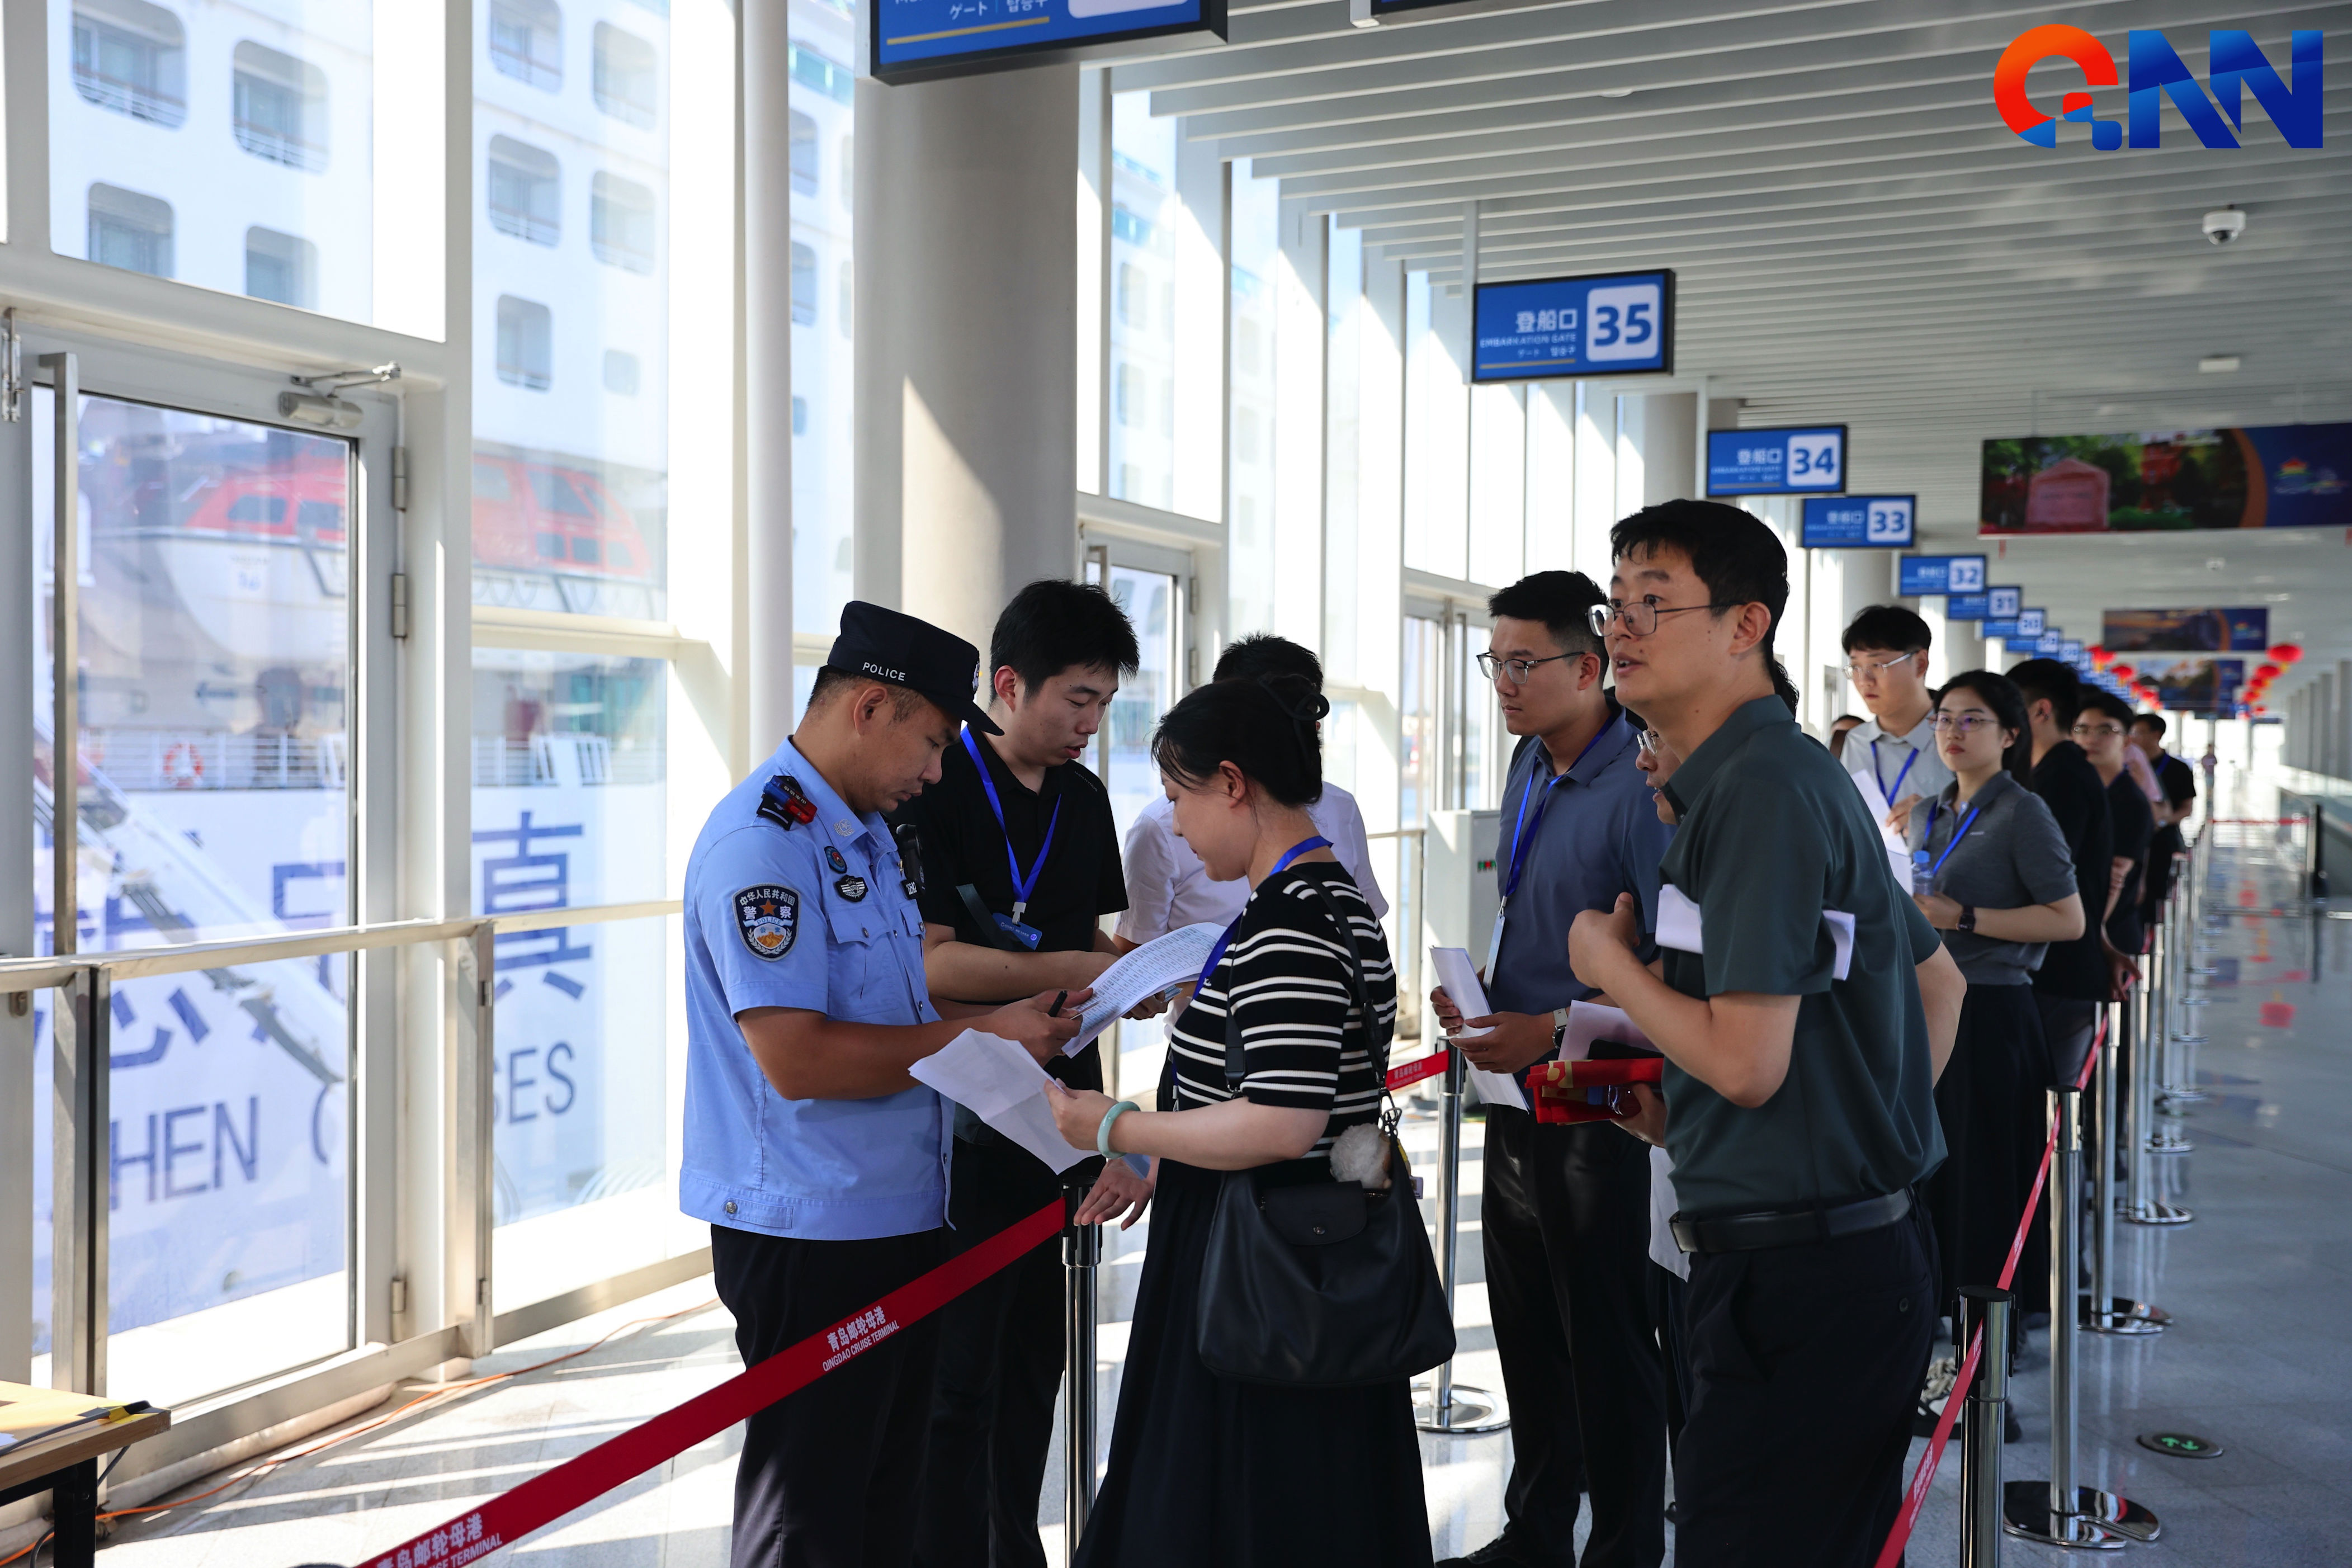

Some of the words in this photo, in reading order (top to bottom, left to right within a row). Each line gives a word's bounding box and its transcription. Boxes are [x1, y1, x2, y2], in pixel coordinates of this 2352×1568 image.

[1515, 309, 1578, 333] 登船口
[1594, 303, 1652, 347] 35
[1480, 336, 1550, 348] EMBARKATION
[1551, 333, 1576, 343] GATE
[1793, 448, 1834, 475] 34
[1874, 511, 1905, 532] 33
[1956, 566, 1978, 584] 32
[862, 662, 905, 681] POLICE
[739, 889, 795, 906] 中华人民共和国
[743, 906, 757, 919] 警
[780, 905, 791, 918] 察
[827, 1305, 886, 1352] 青岛邮轮母港
[823, 1348, 851, 1372] QINGDAO
[851, 1335, 872, 1355] CRUISE
[871, 1320, 900, 1343] TERMINAL
[451, 1533, 503, 1567] TERMINAL
